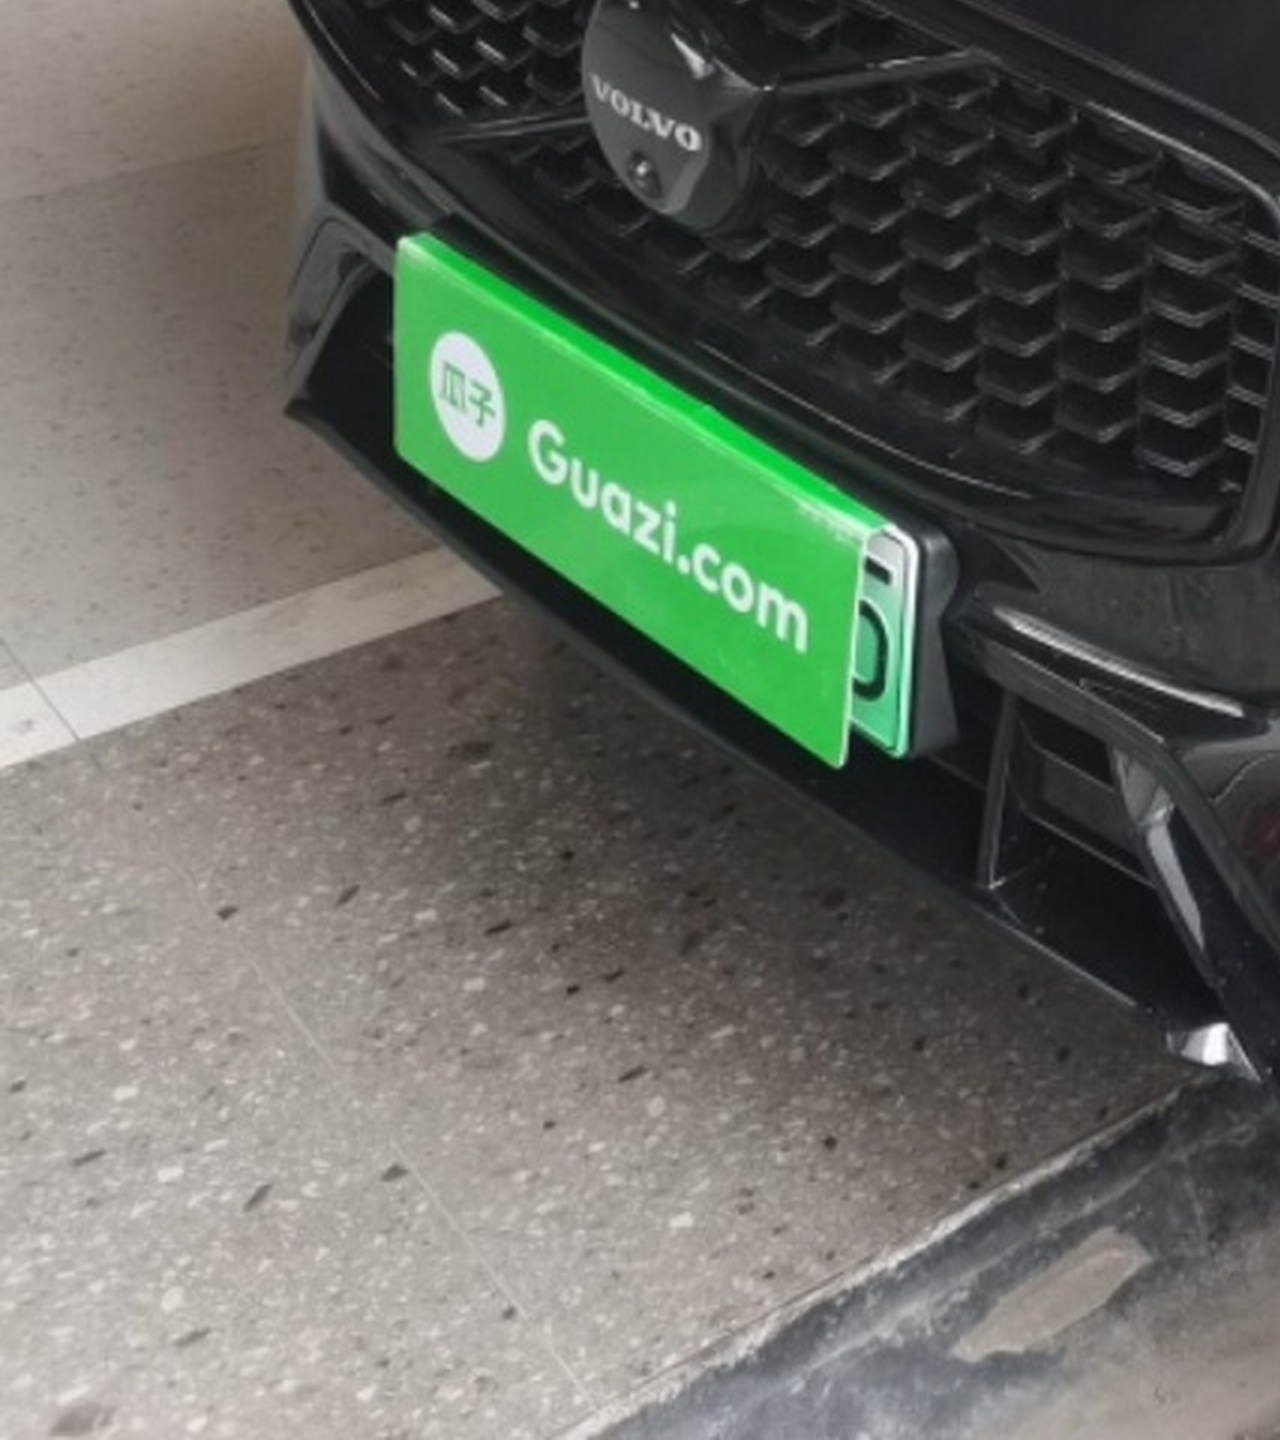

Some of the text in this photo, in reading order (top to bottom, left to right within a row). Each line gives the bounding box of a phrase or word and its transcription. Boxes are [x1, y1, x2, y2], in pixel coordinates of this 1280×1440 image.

[590, 72, 702, 151] VOLVO
[438, 360, 497, 428] 瓜子
[527, 418, 809, 654] Guazi.com
